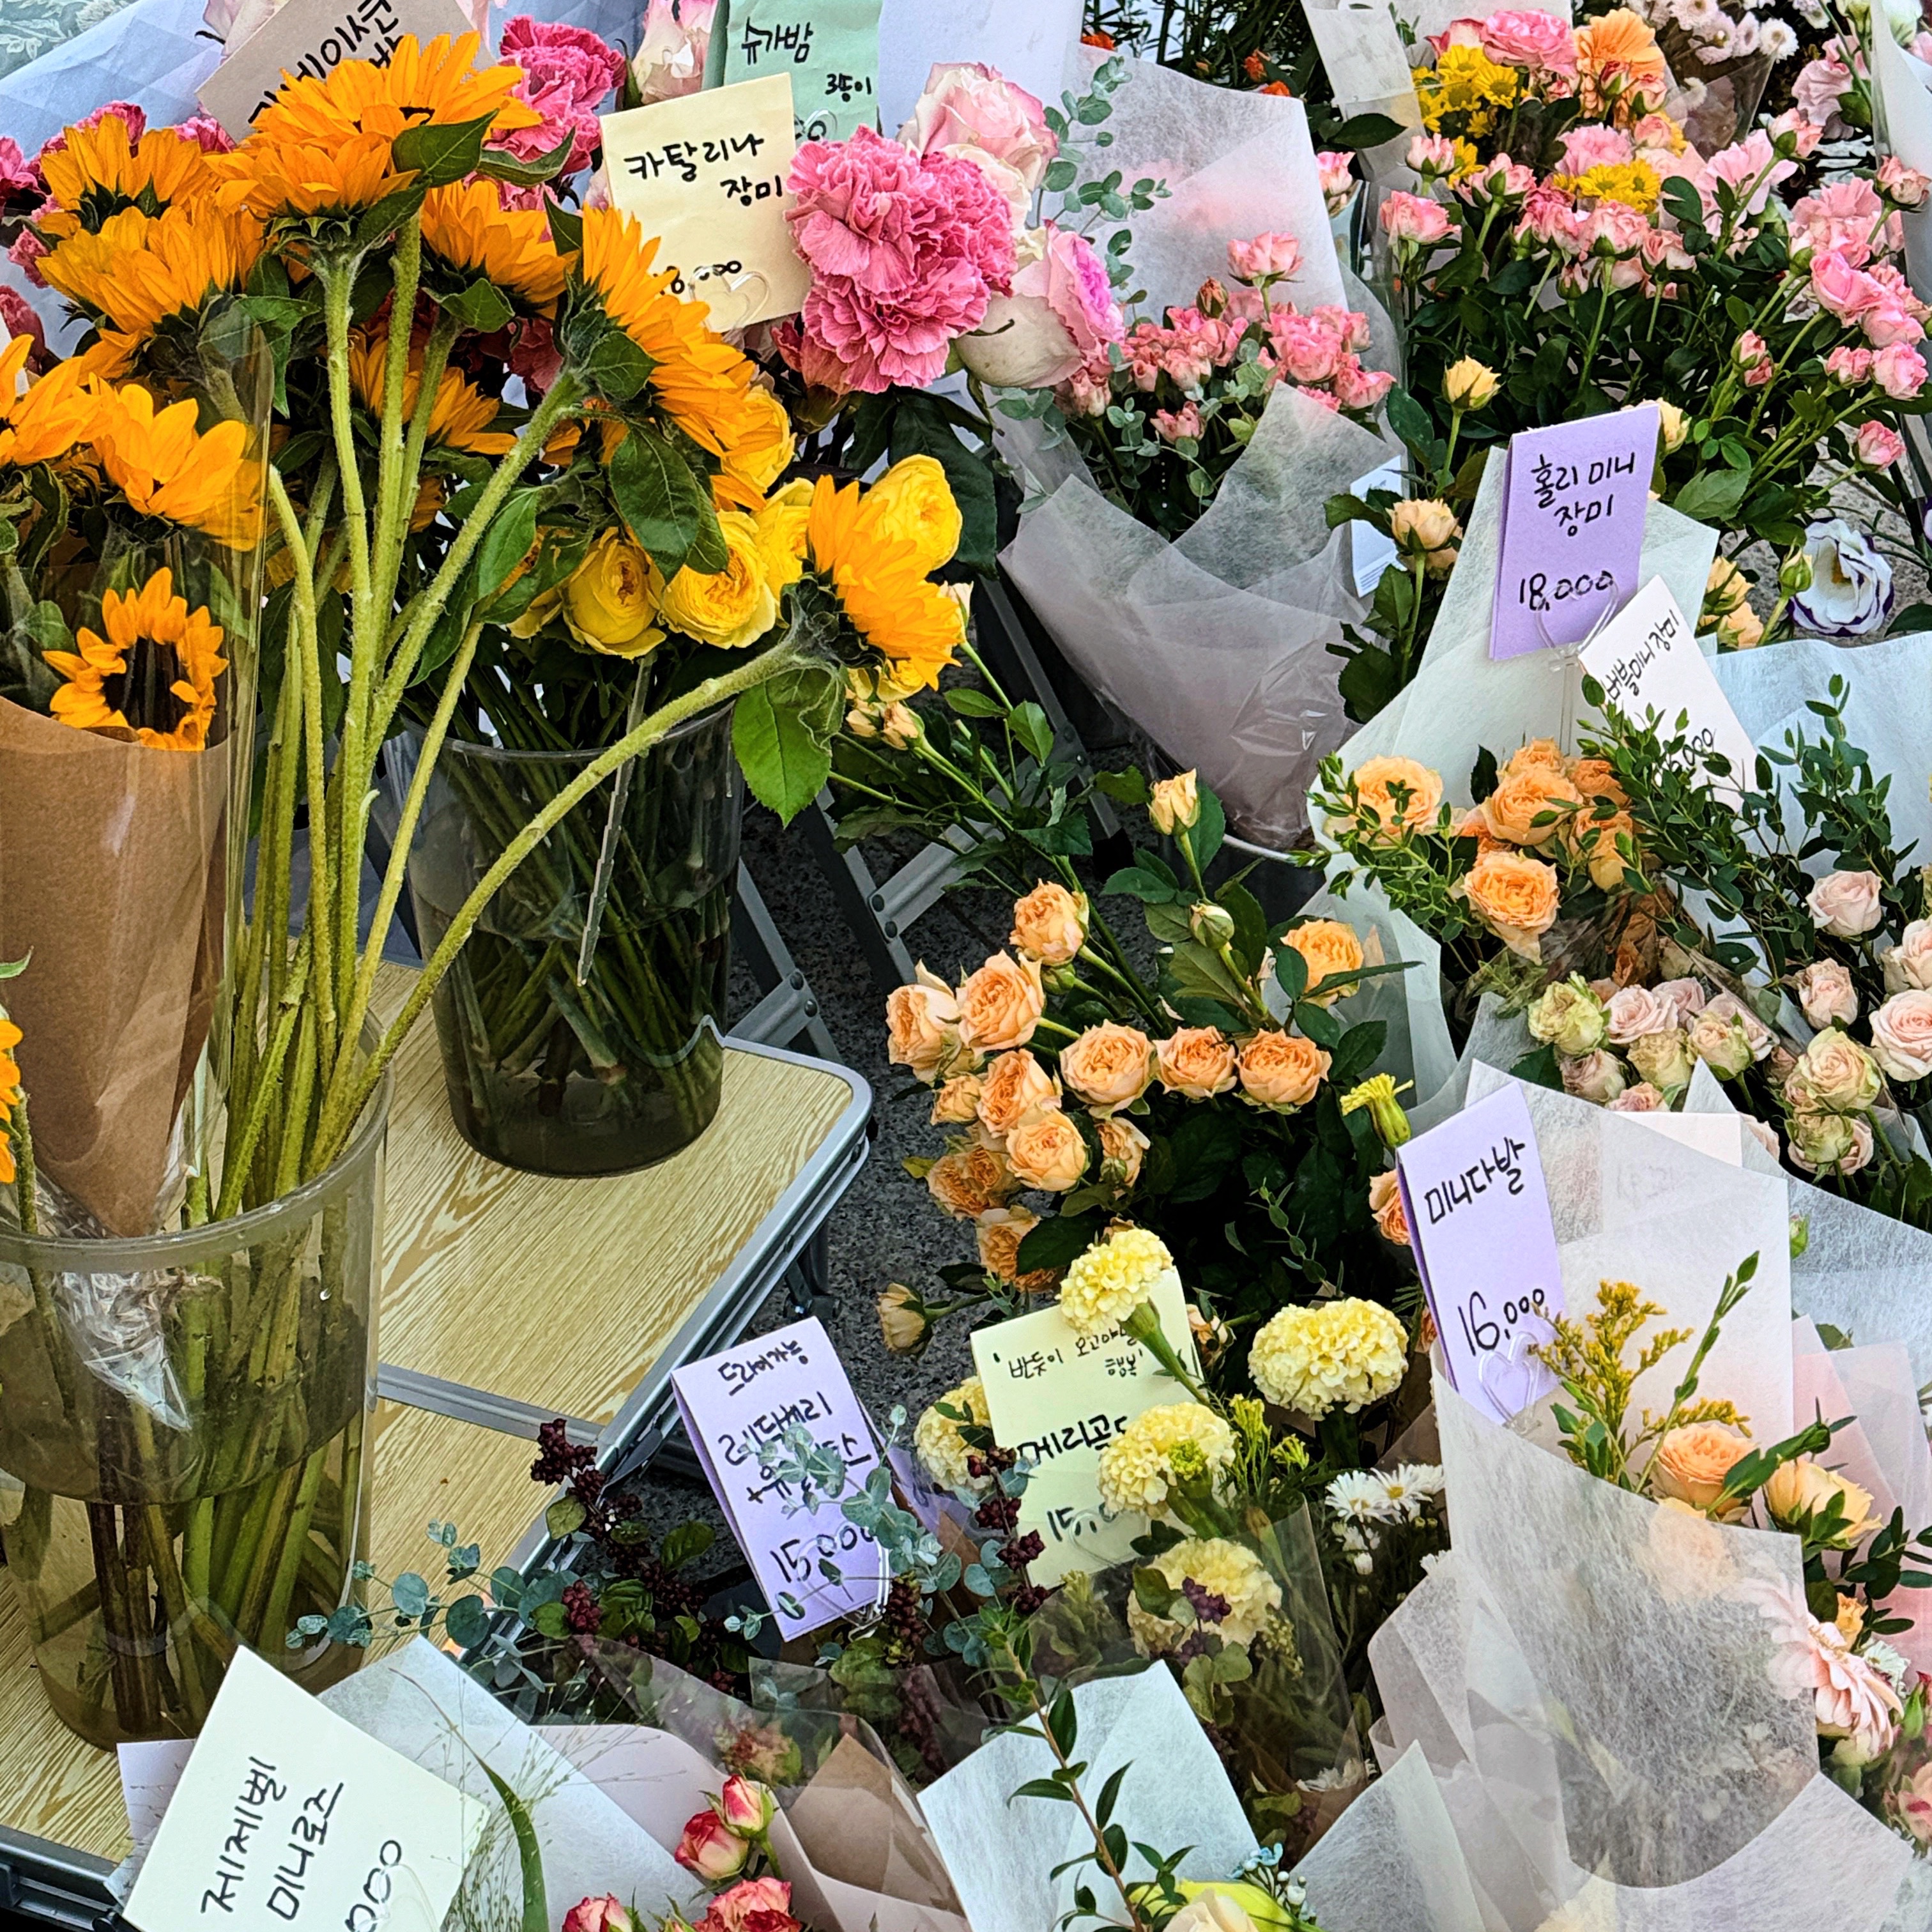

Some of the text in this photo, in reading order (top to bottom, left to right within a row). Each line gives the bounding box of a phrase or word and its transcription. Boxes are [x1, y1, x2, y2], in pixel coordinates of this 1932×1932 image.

[741, 17, 813, 65] 슈가밤
[624, 133, 765, 182] 카탈리나
[720, 174, 783, 206] 장미
[1530, 452, 1636, 509] 홀리 미니
[1553, 494, 1614, 537] 장미
[1519, 570, 1614, 612] 18,000
[1423, 1137, 1526, 1225] 미니다발
[1457, 1288, 1545, 1356] 16,000
